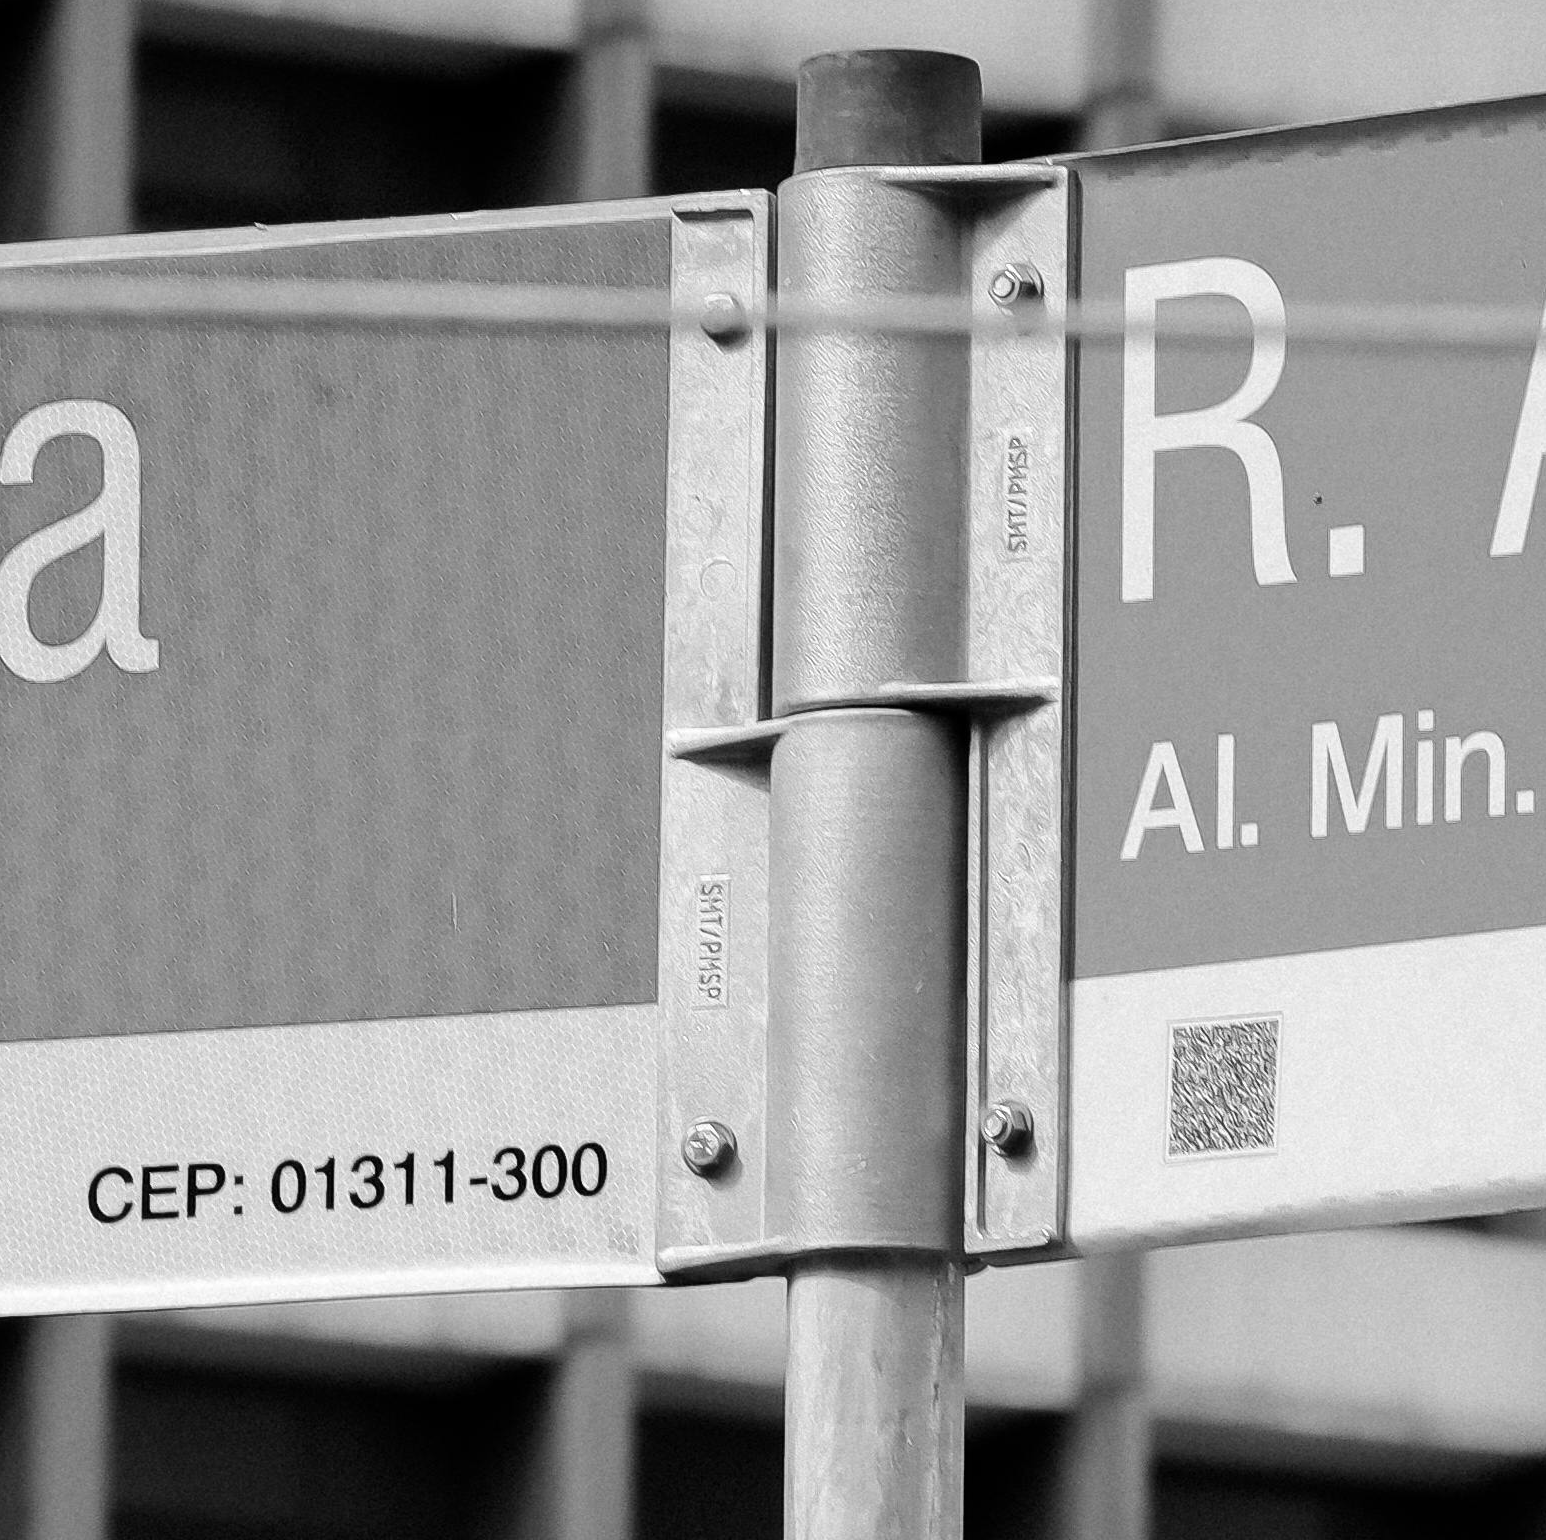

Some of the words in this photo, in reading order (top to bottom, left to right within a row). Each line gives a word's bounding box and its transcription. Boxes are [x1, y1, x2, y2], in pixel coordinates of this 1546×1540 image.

[1120, 256, 1366, 604] R.
[1120, 741, 1259, 861] Al.
[1311, 710, 1535, 838] Min.
[86, 1159, 246, 1225] CEP:
[270, 1141, 610, 1215] 01311-300
